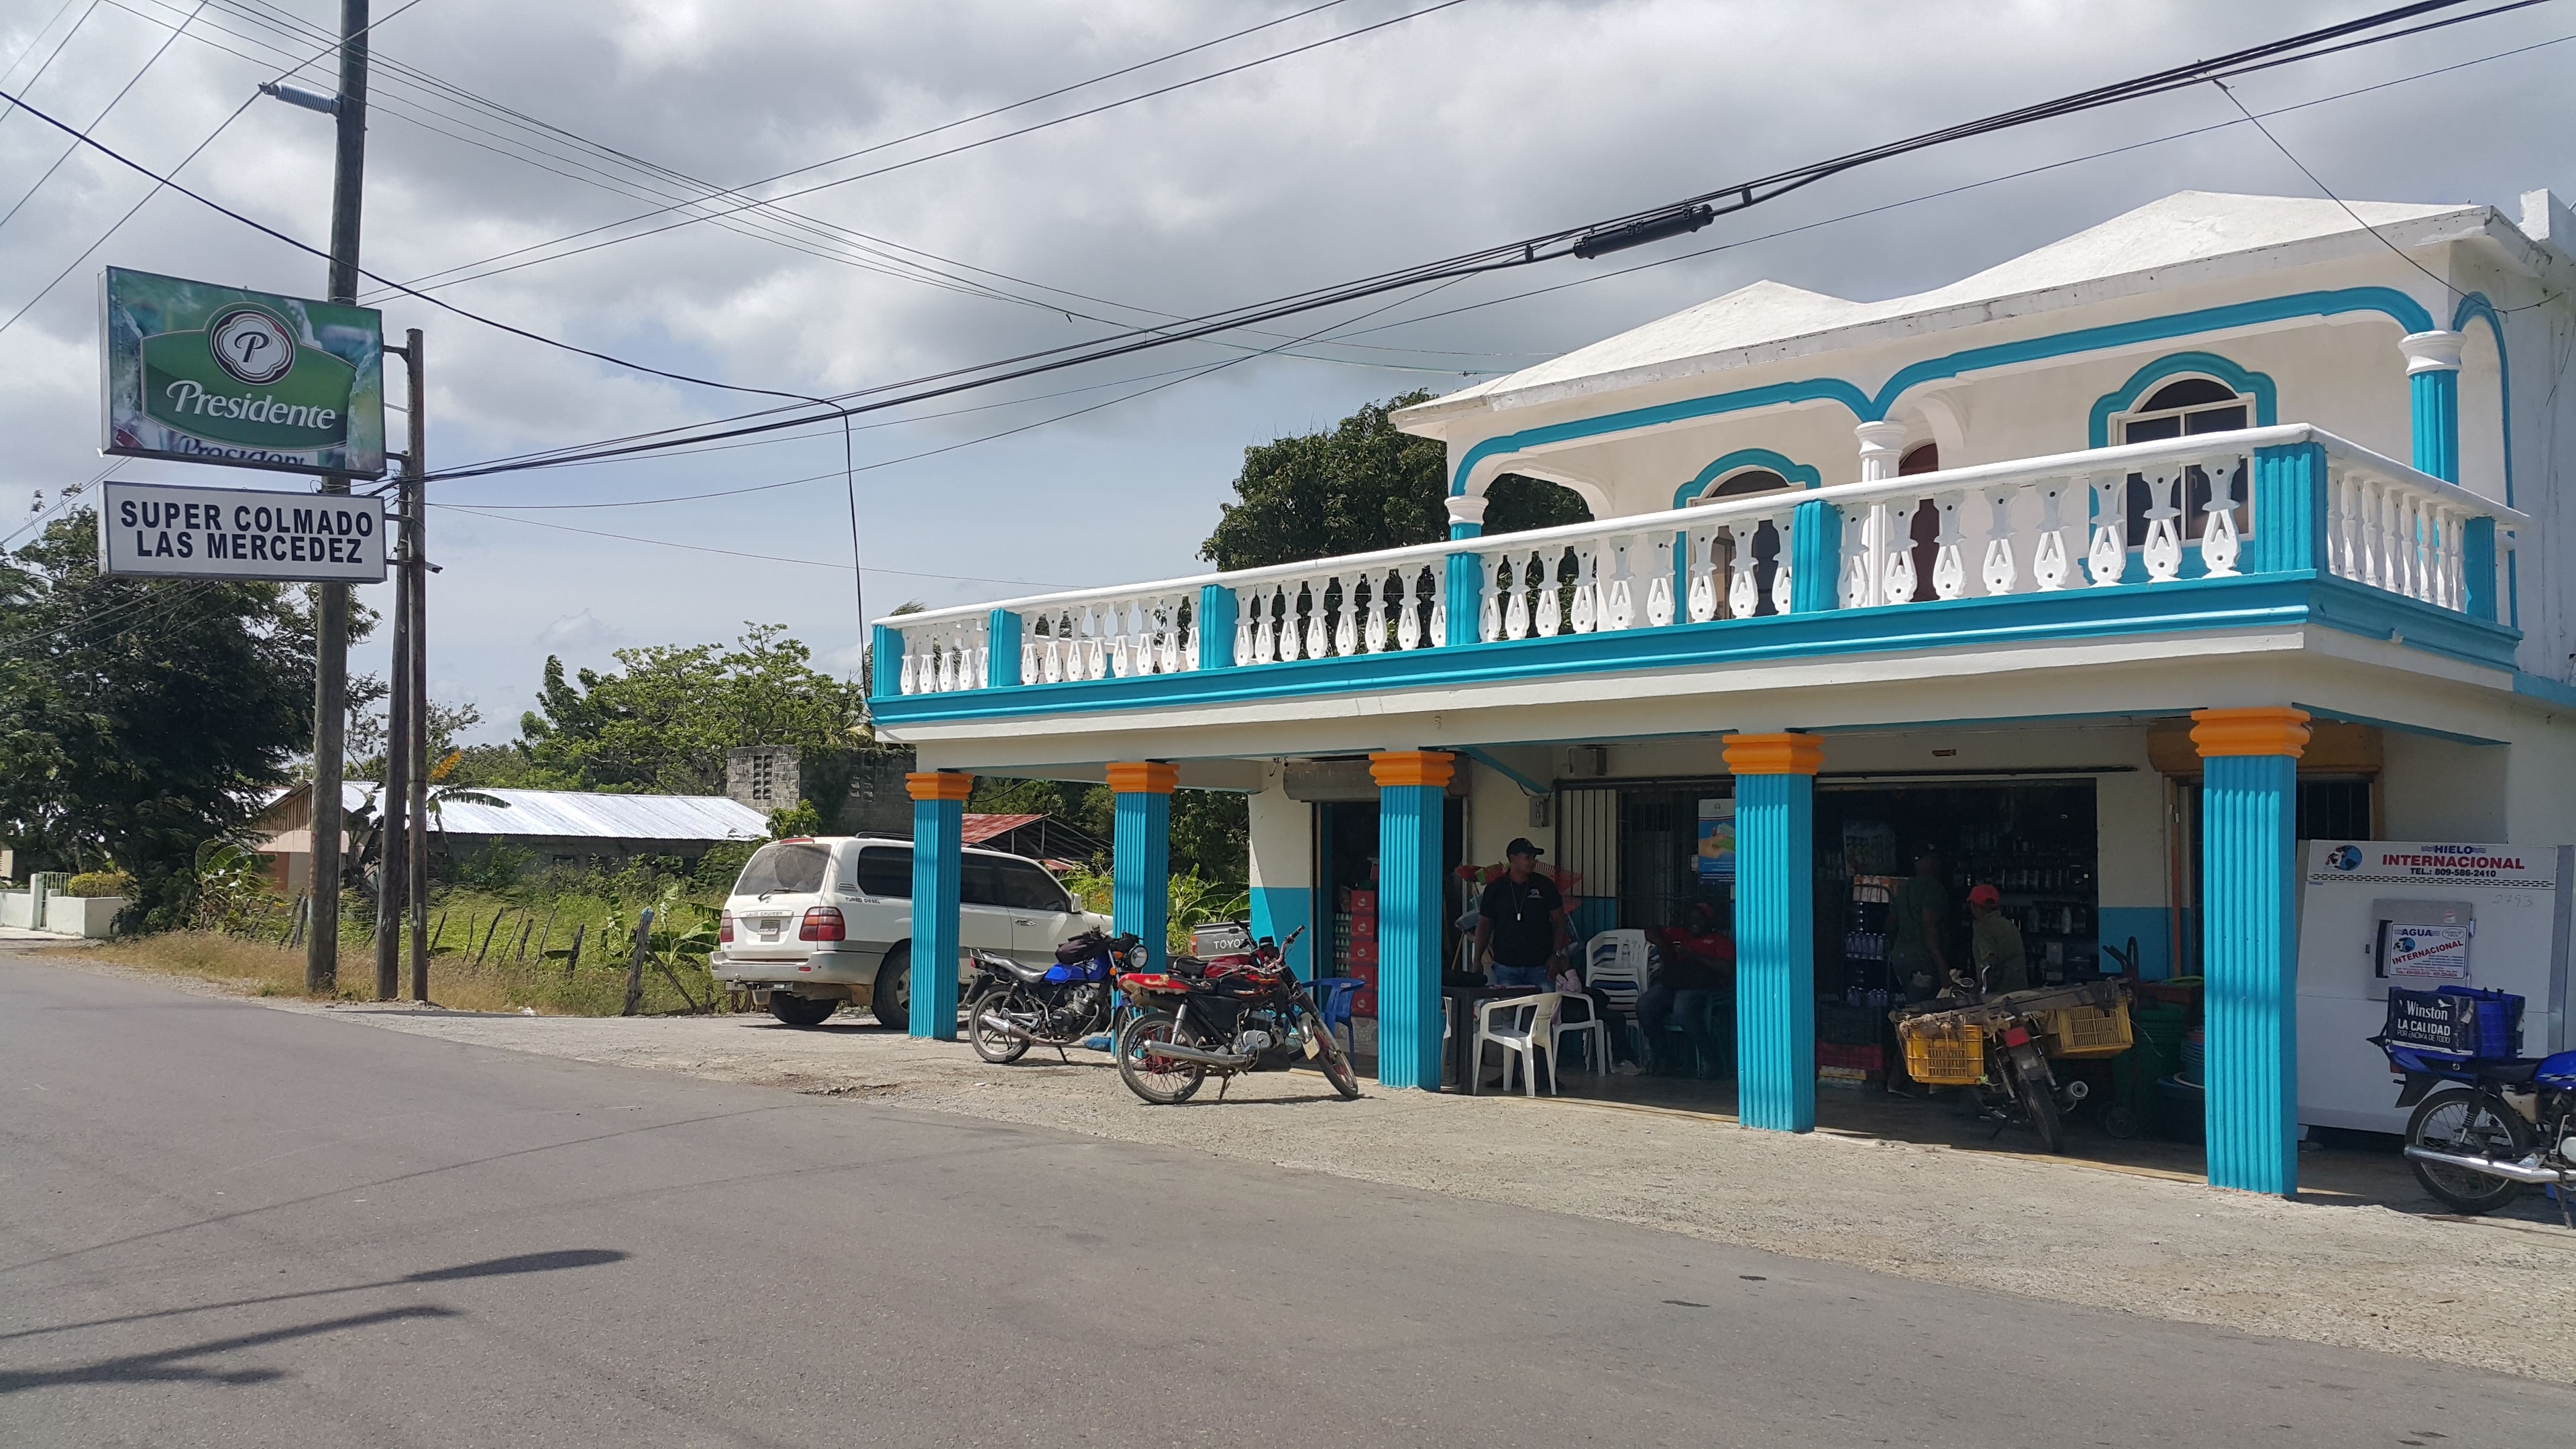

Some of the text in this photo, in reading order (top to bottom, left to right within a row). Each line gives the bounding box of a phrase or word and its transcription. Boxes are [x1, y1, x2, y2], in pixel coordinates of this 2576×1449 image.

[166, 380, 335, 430] Presidente
[121, 500, 374, 537] SUPER COLMADO
[137, 530, 363, 564] LAS MERCEDEZ
[2434, 845, 2473, 855] HIELO
[2382, 854, 2525, 869] INTERNACIONAL
[2410, 867, 2496, 877] TEL.: 809-586-2410
[2402, 928, 2432, 936] AGUA
[1213, 938, 1245, 949] TOYO
[2392, 940, 2463, 965] INTERNACIONAL
[2406, 1000, 2448, 1021] Winston
[2398, 1018, 2451, 1036] LA CALIDAD
[2428, 1034, 2436, 1042] DE
[2436, 1035, 2450, 1043] TODO
